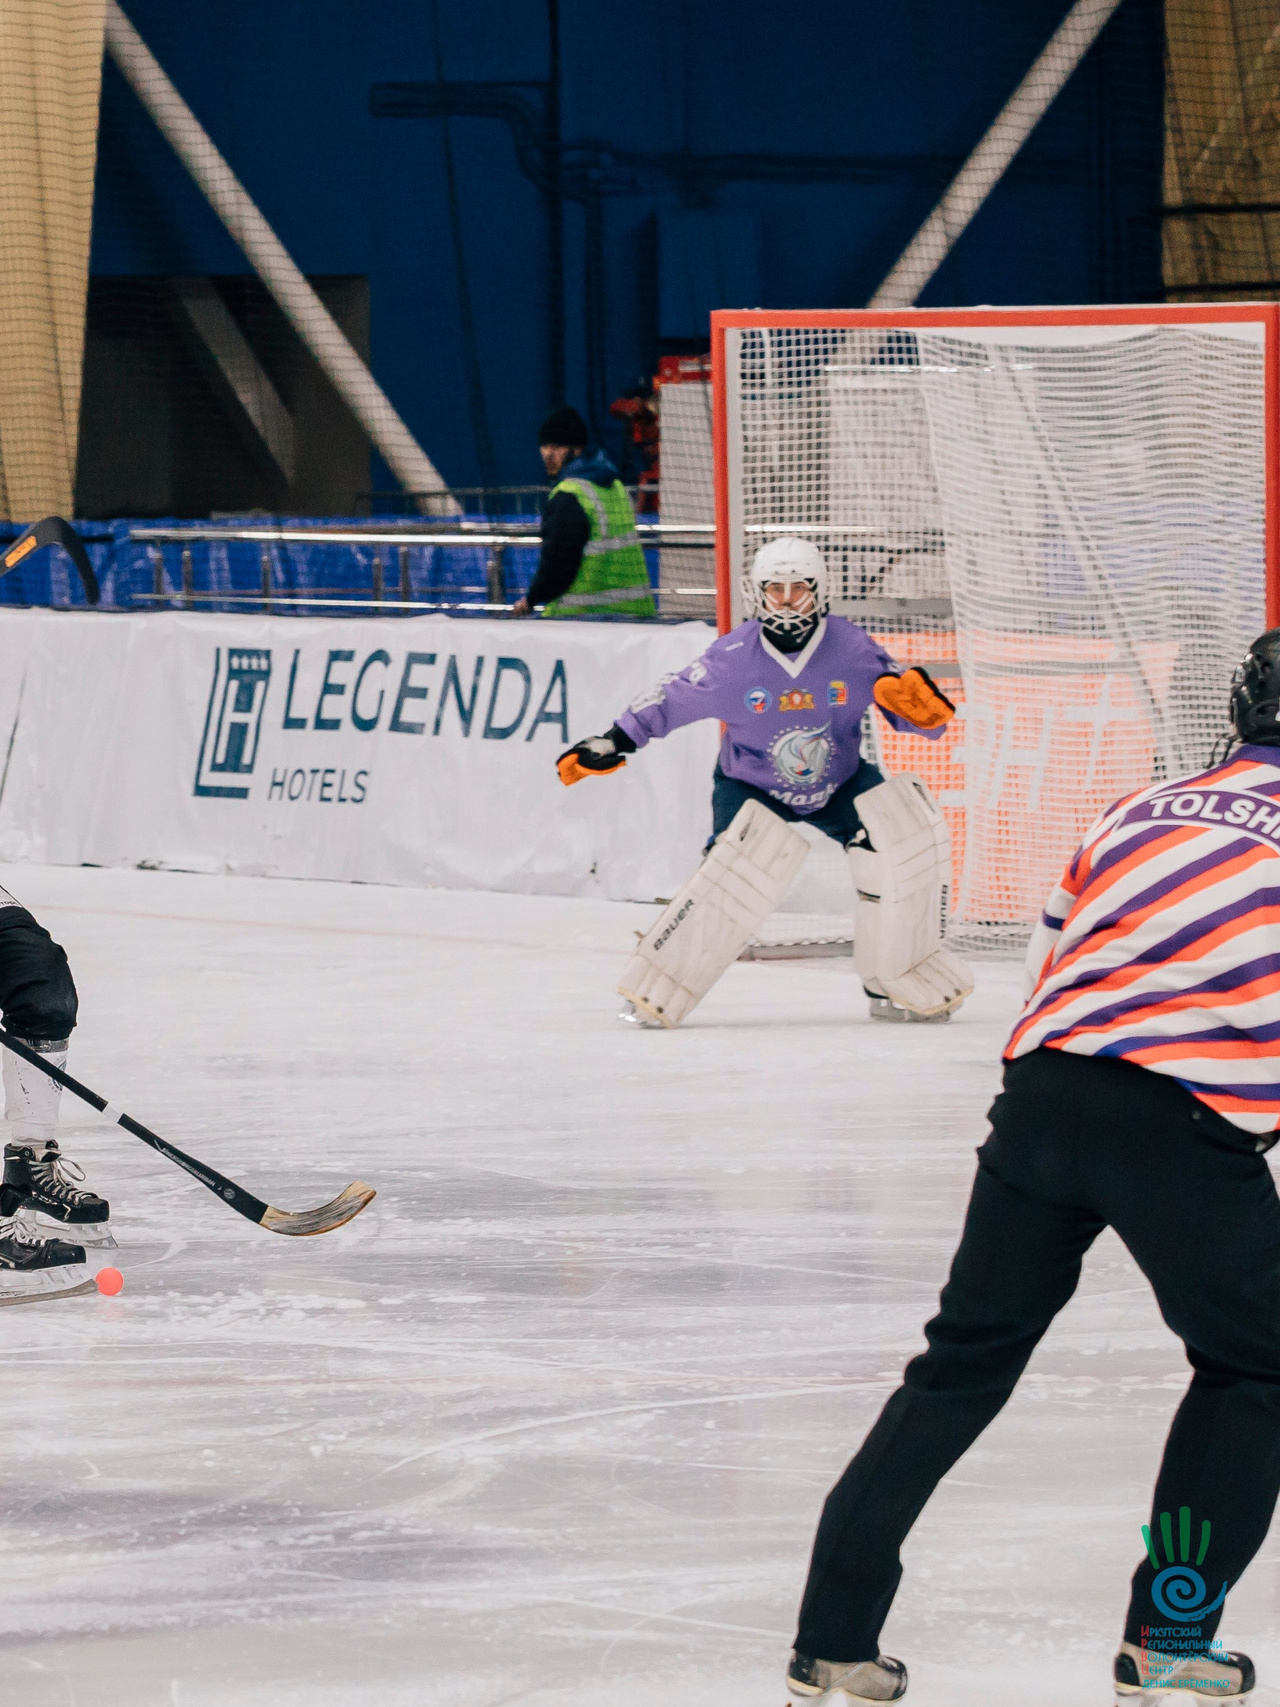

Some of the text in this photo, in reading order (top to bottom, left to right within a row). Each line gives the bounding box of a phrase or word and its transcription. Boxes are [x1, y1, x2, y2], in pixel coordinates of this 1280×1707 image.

[282, 648, 570, 744] LEGENDA
[268, 768, 369, 804] HOTELS
[1149, 793, 1280, 840] TOLSH
